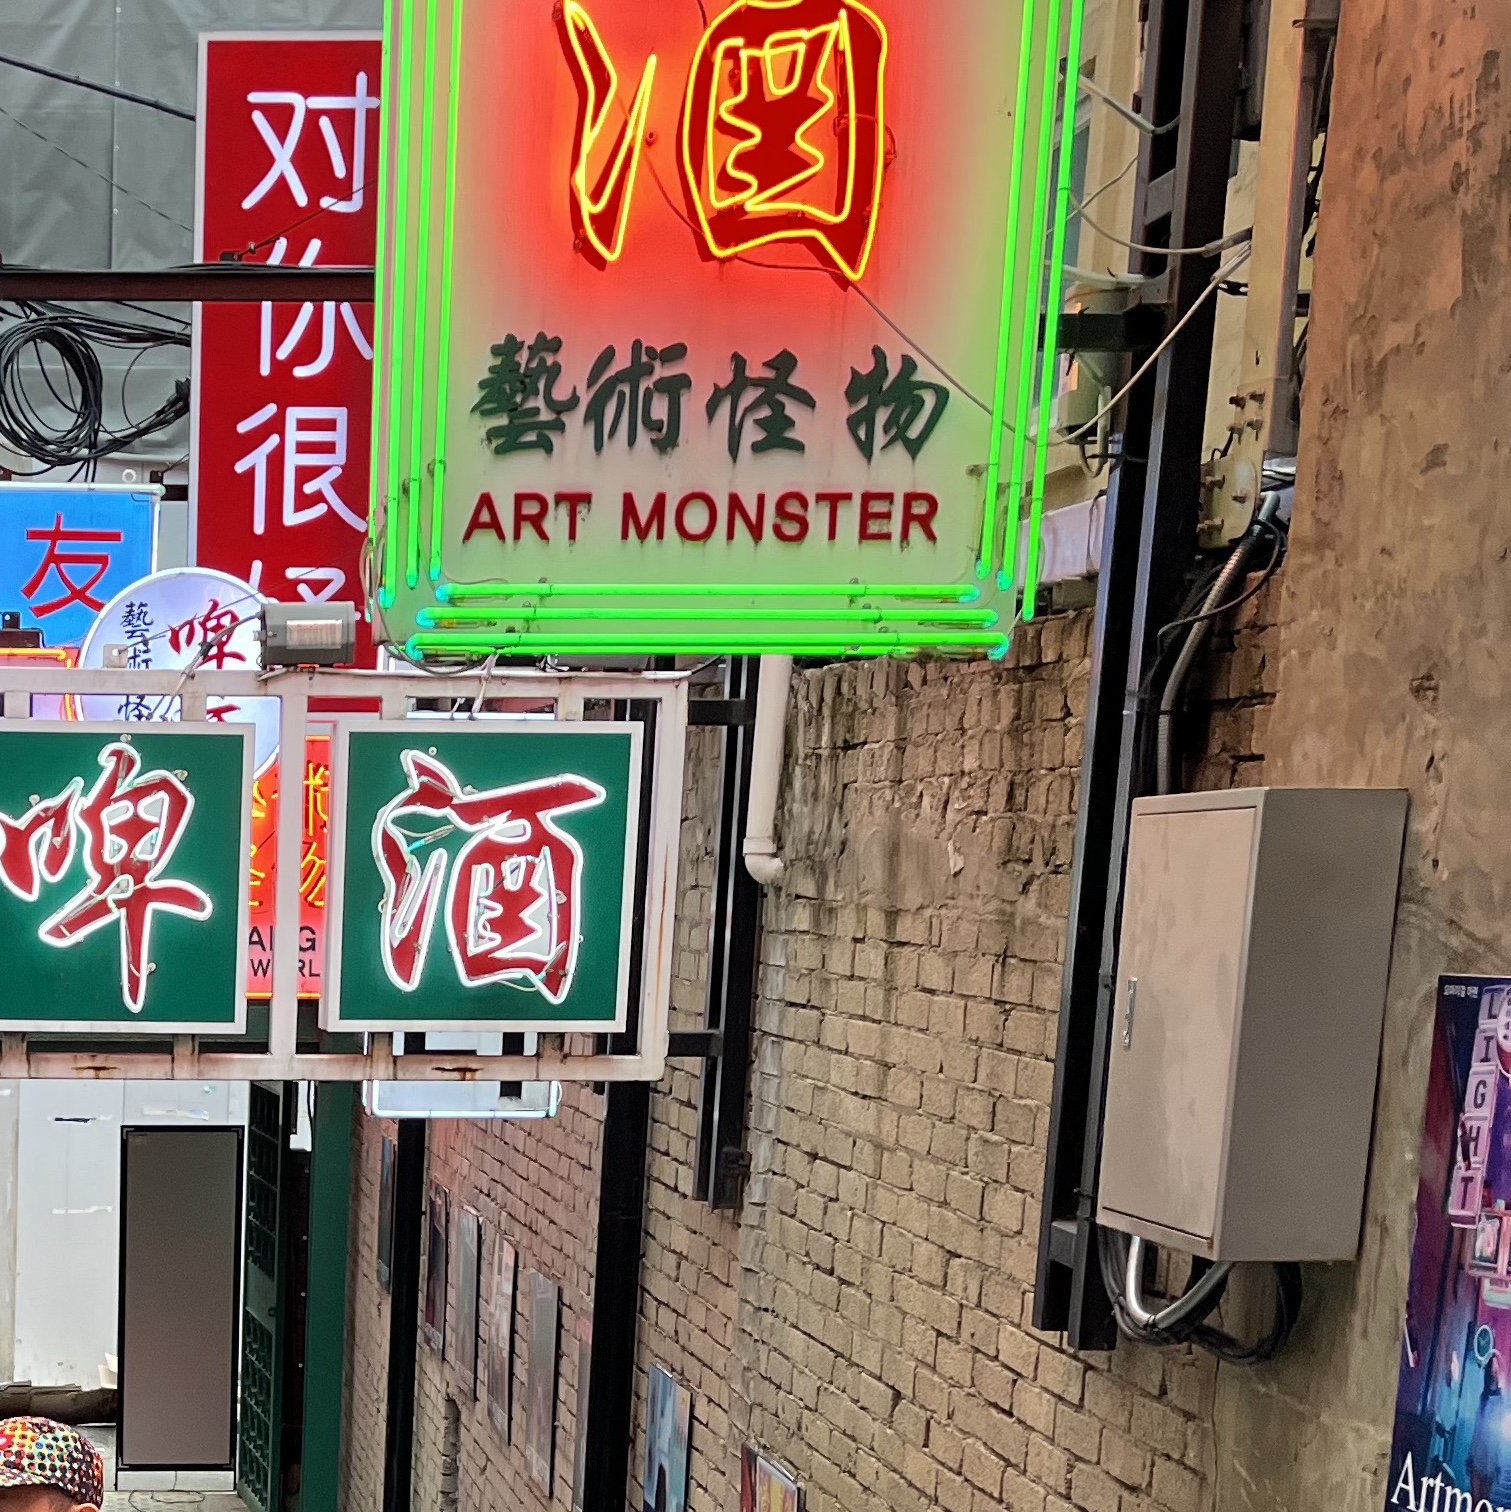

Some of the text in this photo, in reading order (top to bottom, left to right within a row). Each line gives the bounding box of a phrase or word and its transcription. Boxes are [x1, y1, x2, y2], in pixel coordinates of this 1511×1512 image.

[470, 331, 951, 464] 藝術怪物
[462, 491, 940, 543] ART MONSTER
[372, 748, 607, 1005] 酒
